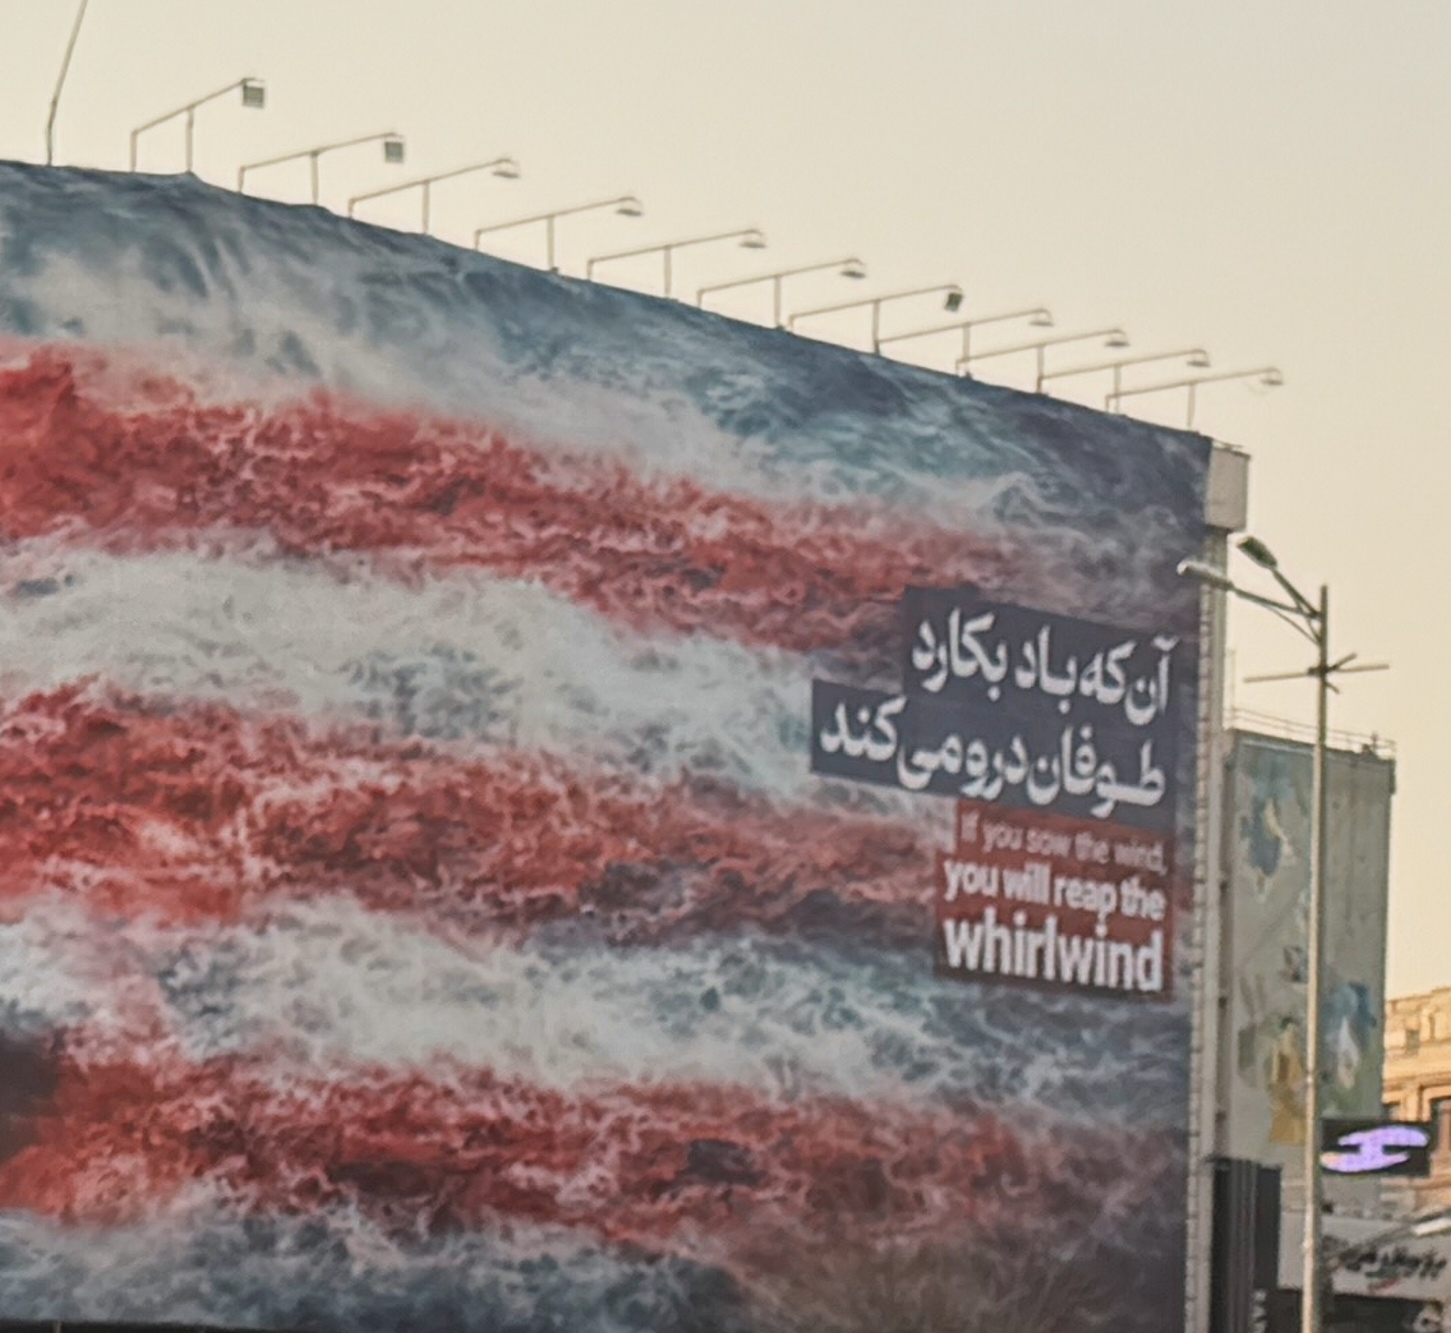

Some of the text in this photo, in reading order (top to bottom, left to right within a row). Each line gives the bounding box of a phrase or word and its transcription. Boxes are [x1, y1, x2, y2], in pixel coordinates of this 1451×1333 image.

[911, 608, 1009, 701] بکارد
[1014, 626, 1078, 714] باد
[1026, 722, 1166, 818] طوفان
[983, 821, 1024, 853] you
[1026, 826, 1071, 857] sow
[1075, 829, 1110, 864] the
[944, 859, 1166, 924] you will reap the
[943, 906, 1163, 991] whirlwind
